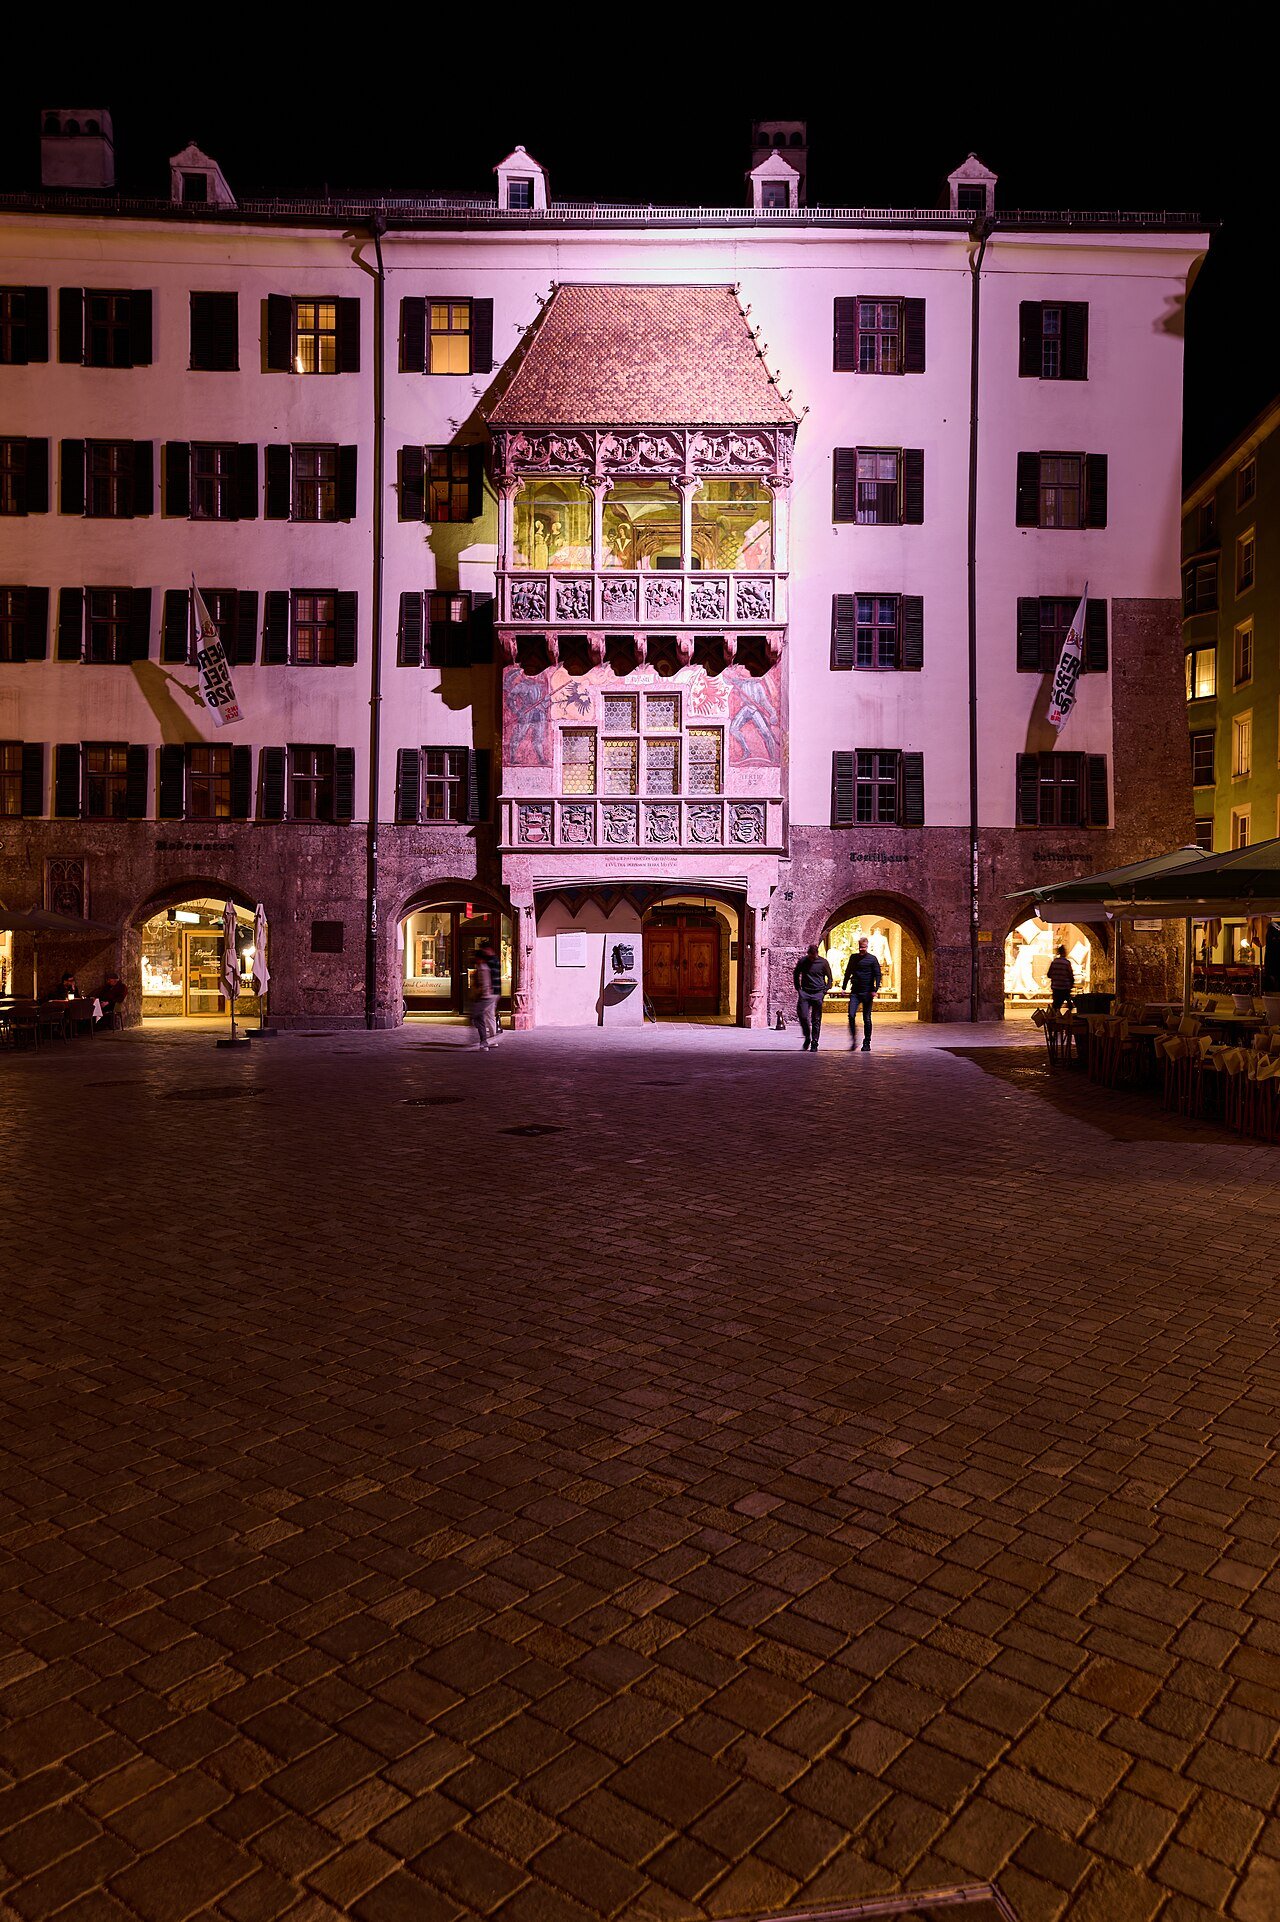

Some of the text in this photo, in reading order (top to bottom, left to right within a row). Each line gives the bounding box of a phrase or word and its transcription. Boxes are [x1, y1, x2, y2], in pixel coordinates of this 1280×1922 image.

[1055, 670, 1077, 698] SEL
[849, 852, 909, 864] Textilhaus
[1032, 850, 1093, 862] Bettwaren
[783, 890, 794, 902] 15
